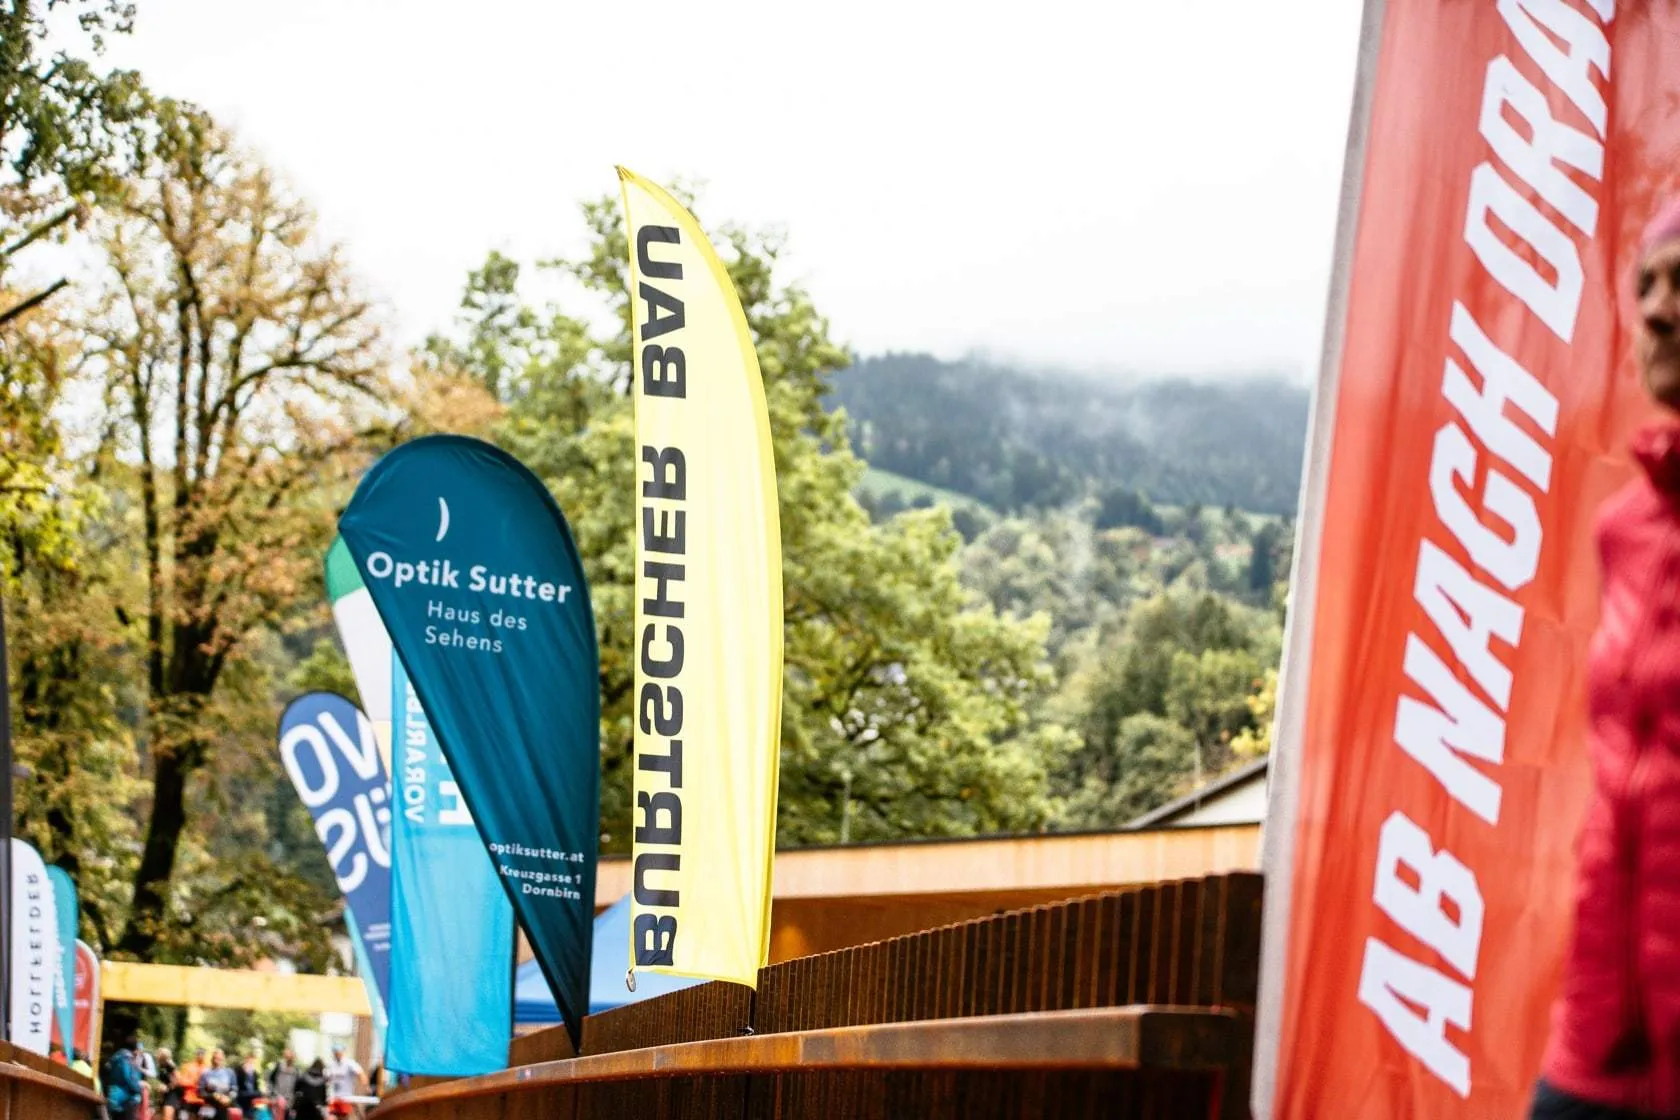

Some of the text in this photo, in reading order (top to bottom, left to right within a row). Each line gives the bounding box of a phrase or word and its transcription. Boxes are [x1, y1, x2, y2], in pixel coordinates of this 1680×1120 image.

[1358, 0, 1616, 1098] AB NACH DRA
[366, 551, 572, 604] Optik Sutter
[427, 600, 528, 631] Haus des
[424, 625, 504, 654] Sehens
[489, 842, 585, 863] optiksutter.at
[500, 864, 582, 885] Kreuzgasse 1
[522, 883, 581, 900] Dornbirn
